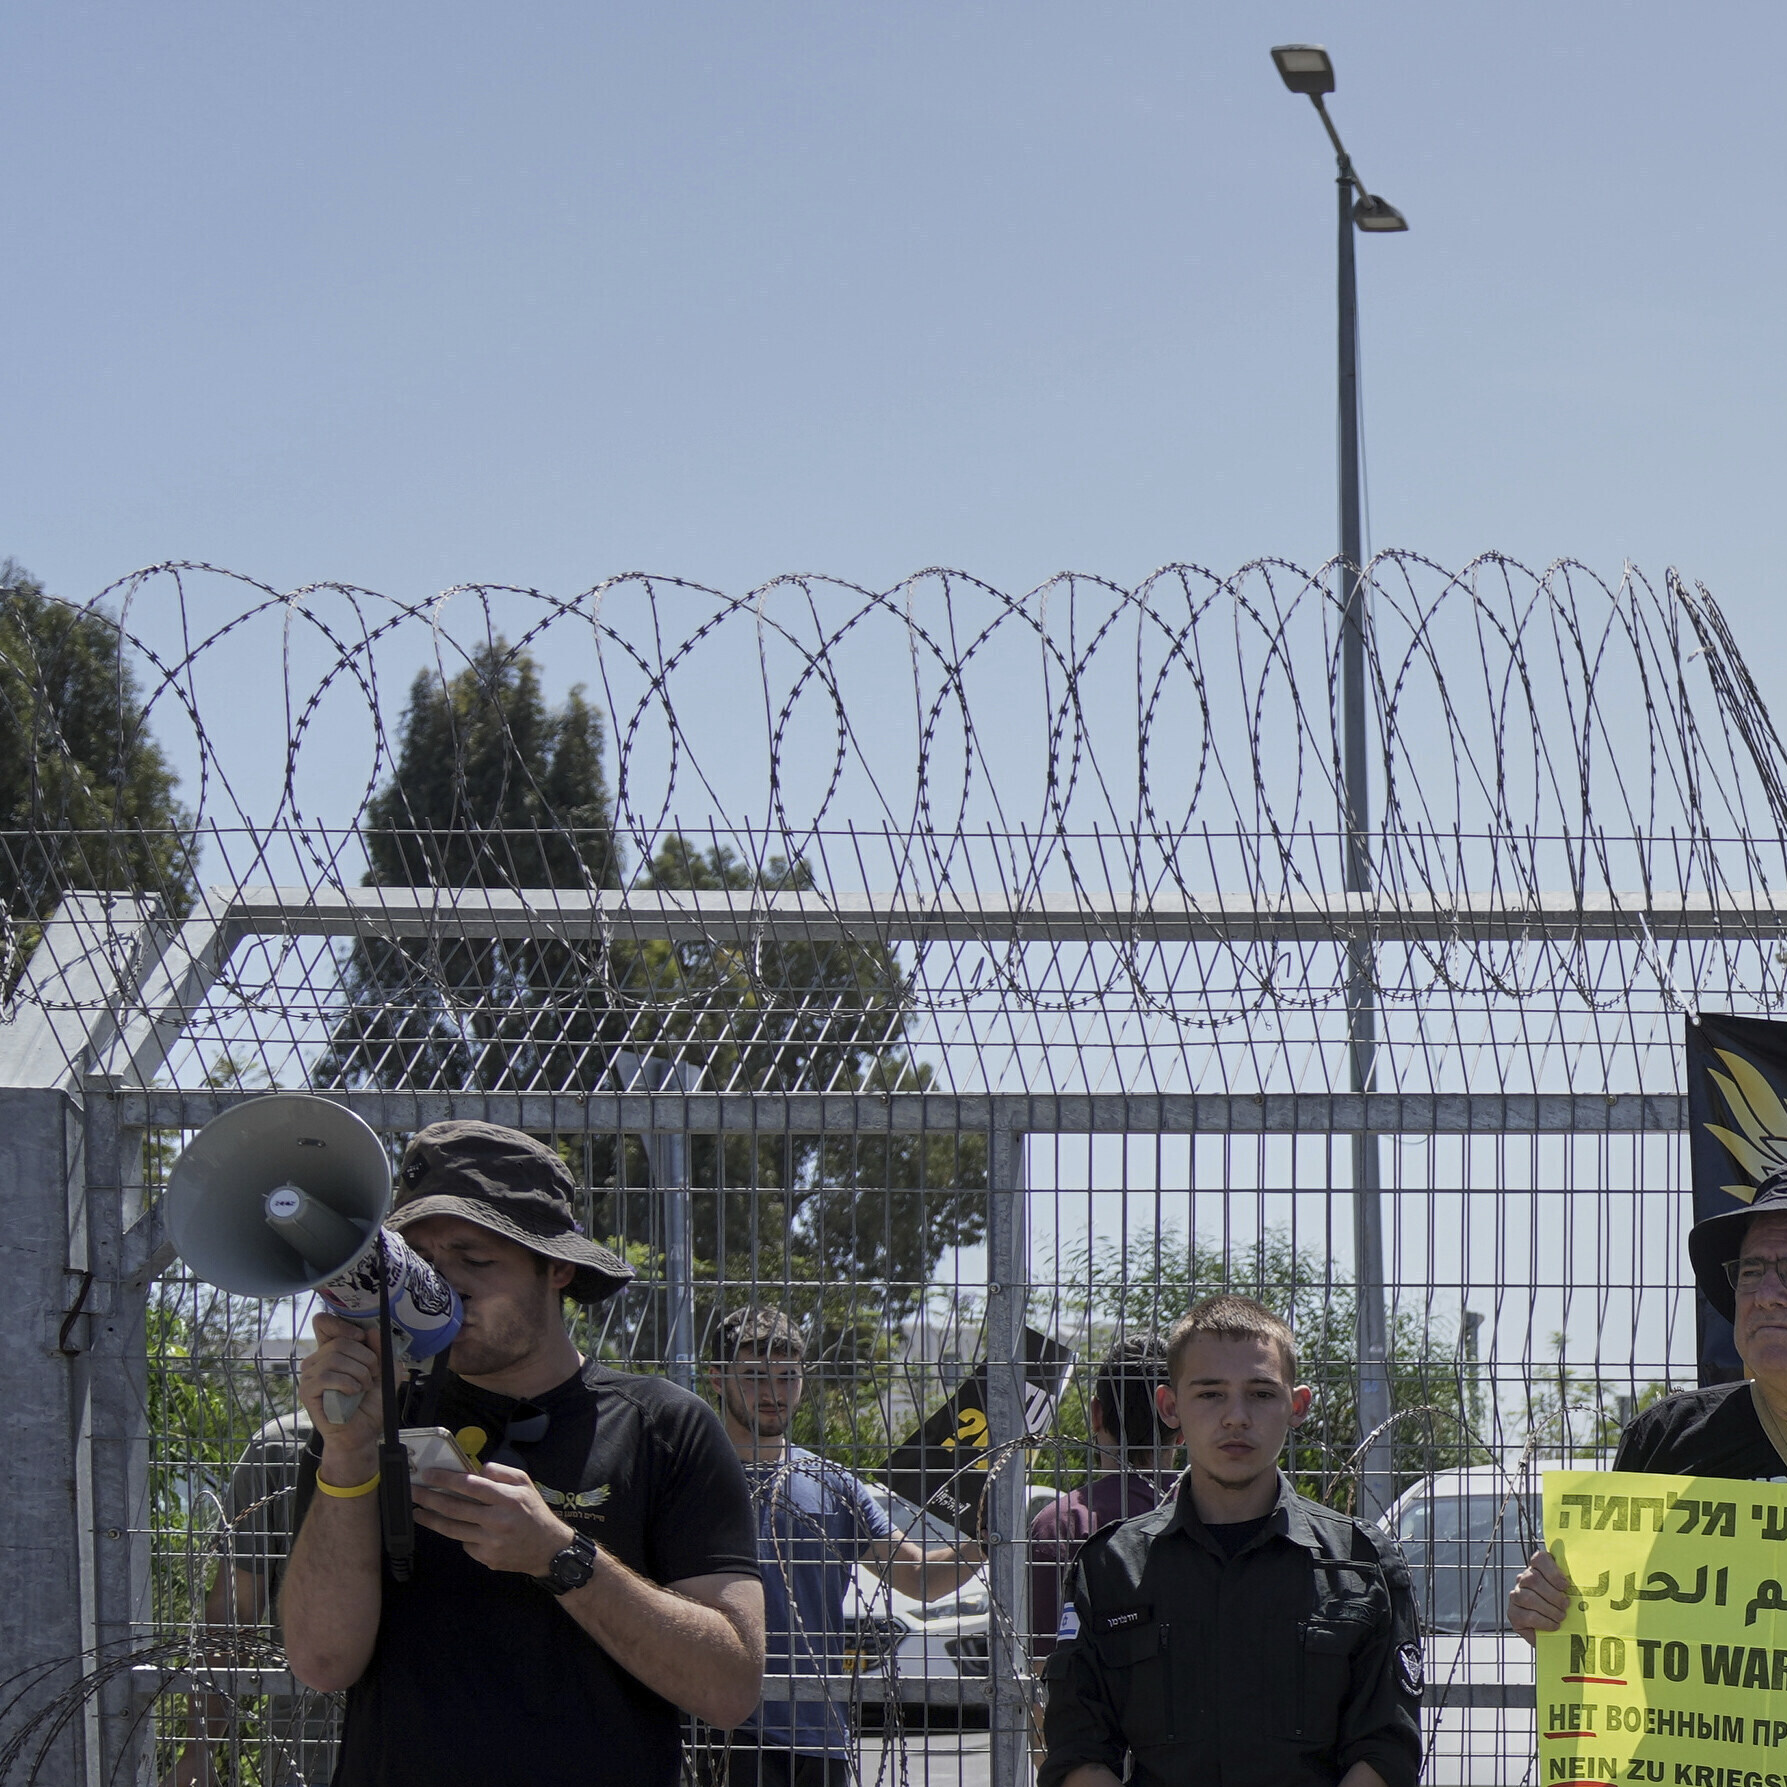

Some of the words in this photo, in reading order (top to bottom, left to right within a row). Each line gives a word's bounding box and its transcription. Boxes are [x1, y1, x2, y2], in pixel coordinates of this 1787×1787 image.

[1559, 1493, 1736, 1538] מלחמה
[1567, 1565, 1728, 1613] الحرب
[1569, 1634, 1625, 1677] NO
[1637, 1639, 1689, 1683] TO
[1549, 1703, 1598, 1732] НЕТ
[1606, 1705, 1744, 1744] ВОЕННЫМ
[1549, 1757, 1618, 1779] NEIN
[1627, 1759, 1665, 1782] ZU
